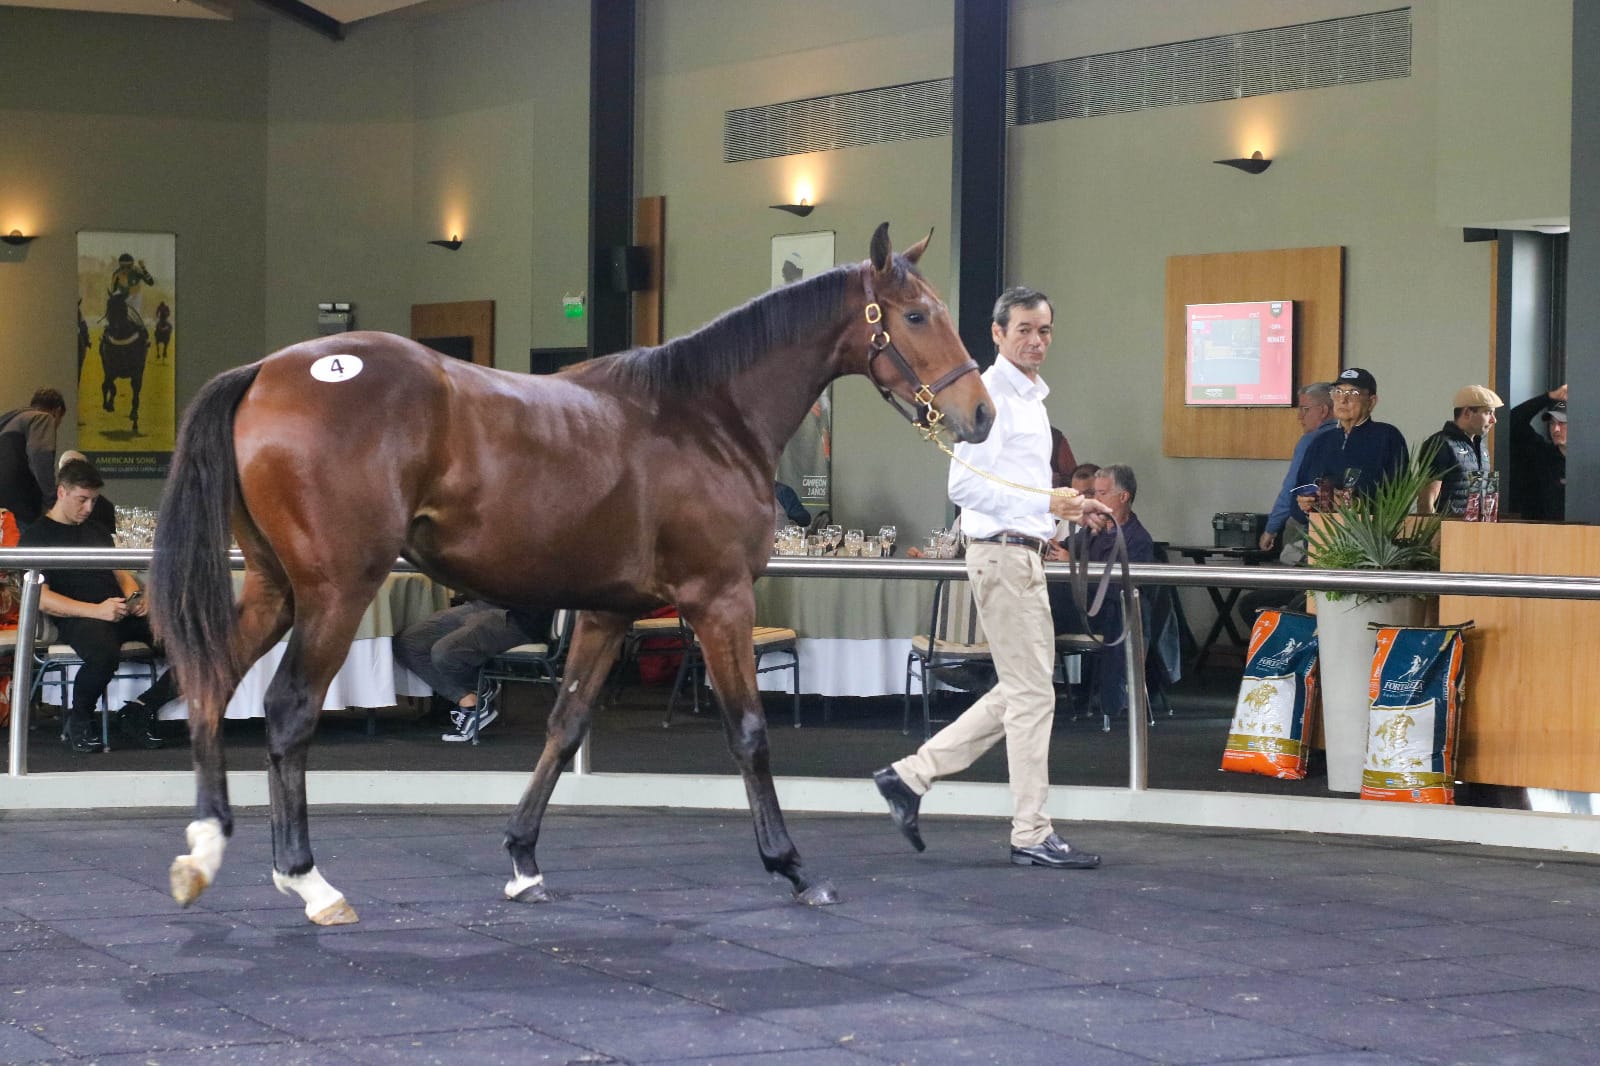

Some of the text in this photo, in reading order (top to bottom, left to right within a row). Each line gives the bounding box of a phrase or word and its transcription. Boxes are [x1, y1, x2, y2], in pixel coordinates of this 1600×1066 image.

[330, 358, 344, 374] 4
[95, 456, 157, 464] AMERICAN SONG
[802, 478, 827, 487] CAMPEÓN
[811, 486, 826, 496] AÑOS
